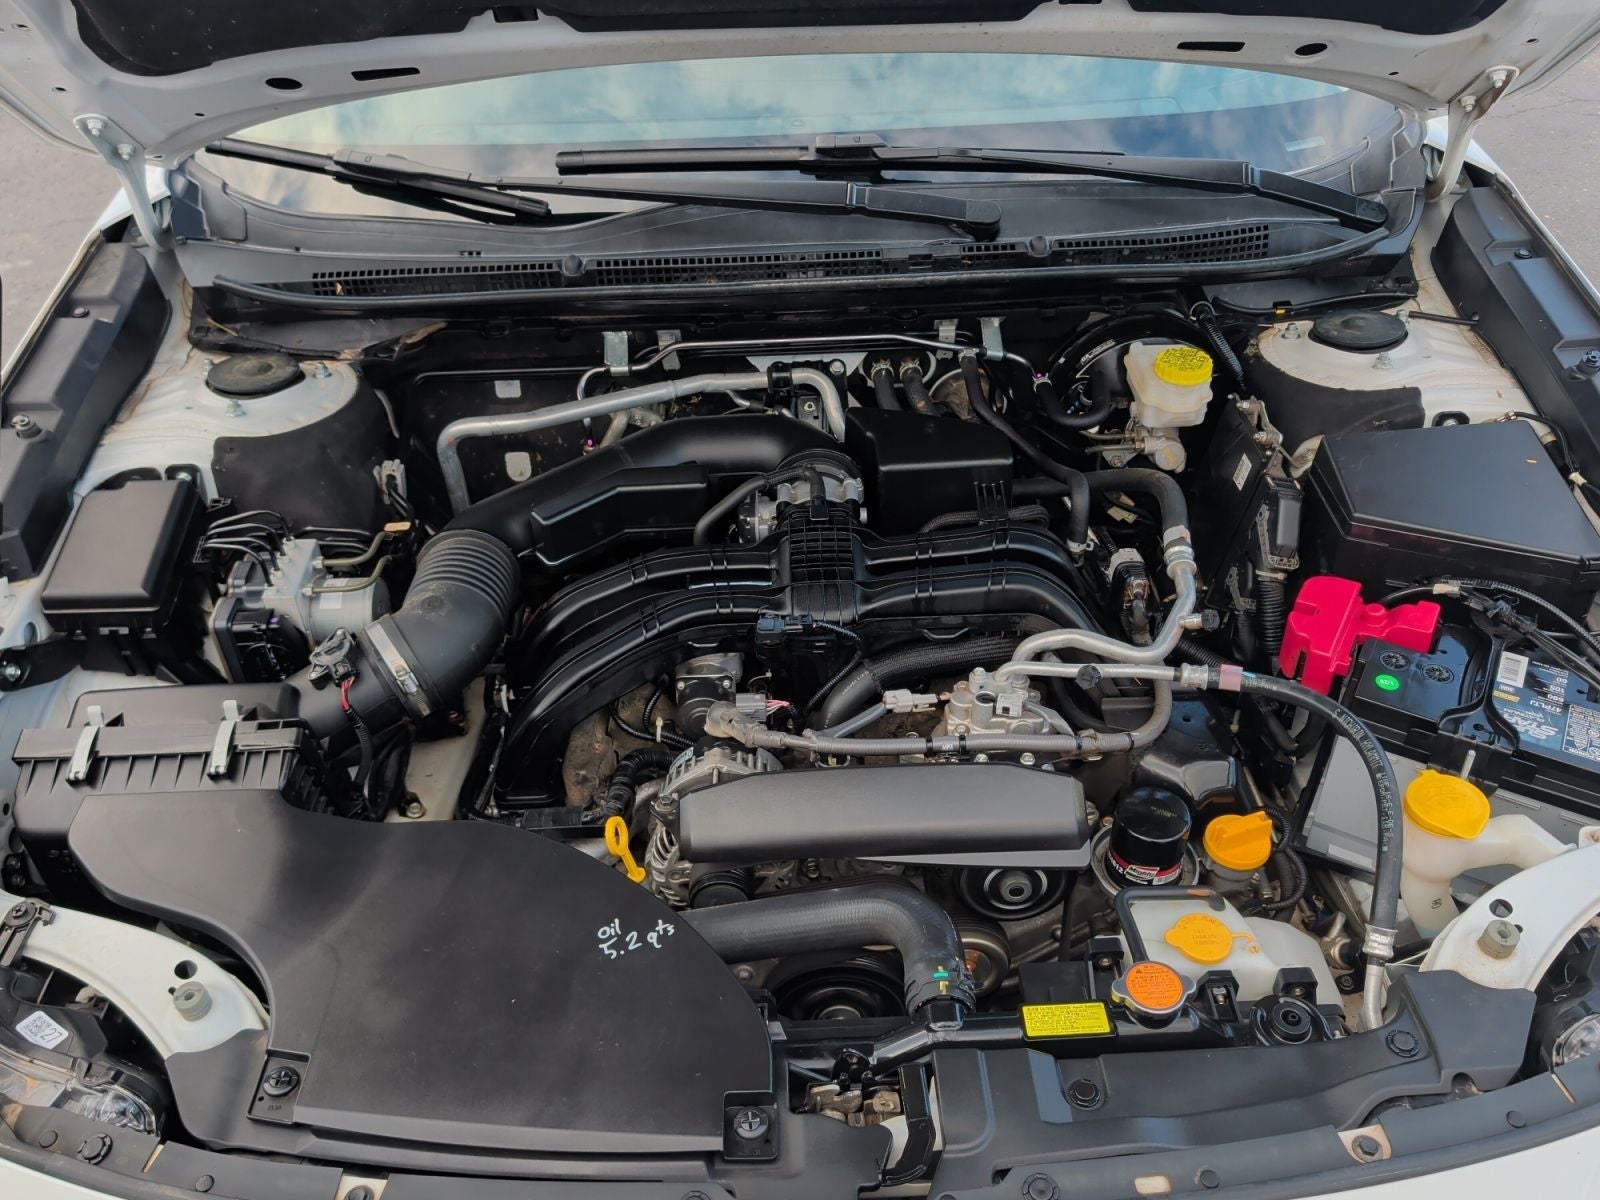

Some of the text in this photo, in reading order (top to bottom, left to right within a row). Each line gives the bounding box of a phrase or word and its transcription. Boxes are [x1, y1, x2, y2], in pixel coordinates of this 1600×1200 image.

[598, 919, 675, 960] 5.2 qts
[40, 1027, 63, 1043] 27
